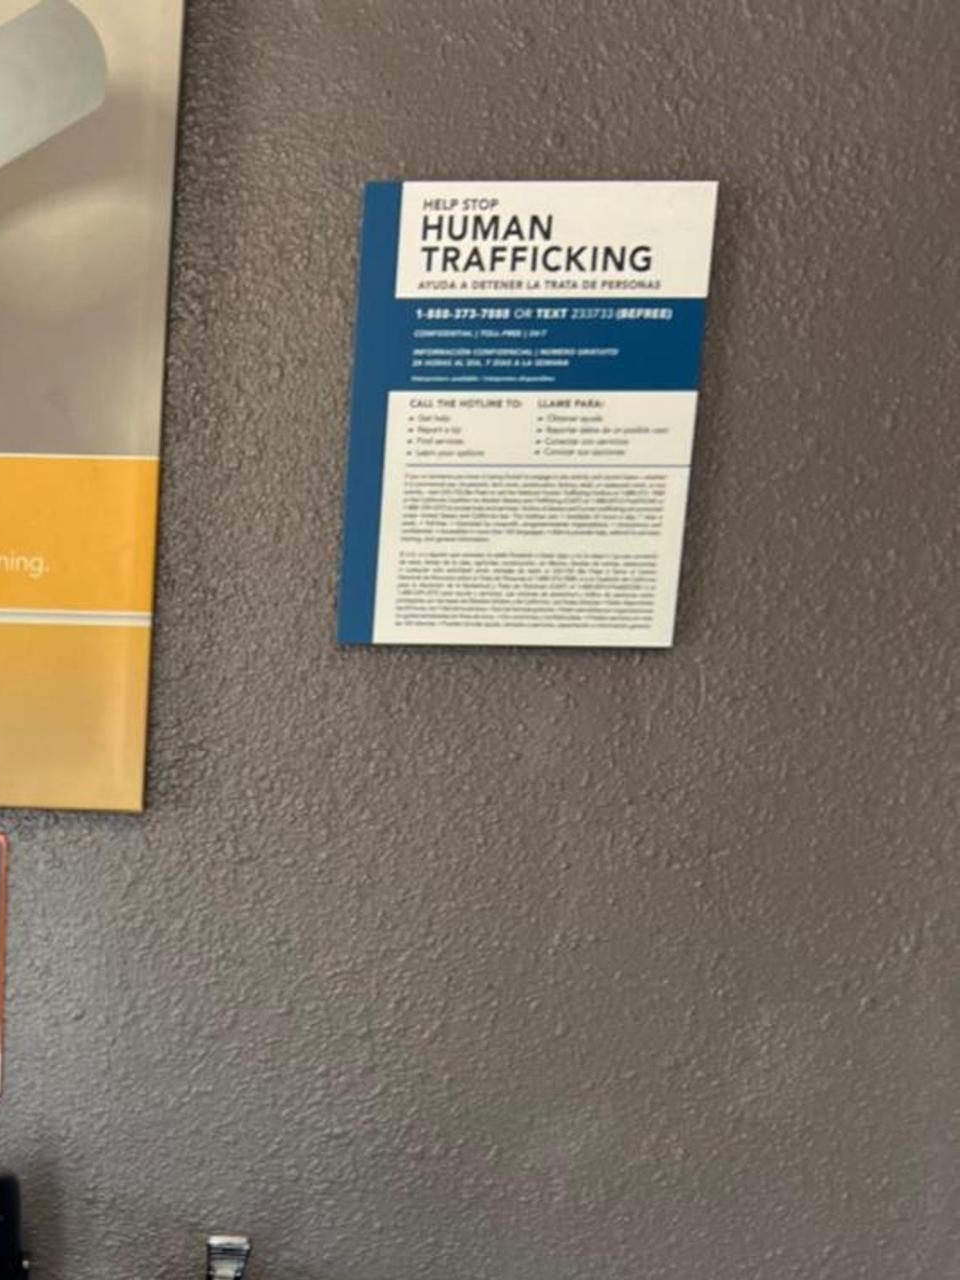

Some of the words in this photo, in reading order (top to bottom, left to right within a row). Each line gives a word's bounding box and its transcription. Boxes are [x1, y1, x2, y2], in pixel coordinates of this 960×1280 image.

[423, 198, 458, 211] HELP
[462, 198, 499, 211] STOP
[420, 214, 553, 241] HUMAN
[420, 245, 653, 272] TRAFFICKING
[418, 280, 456, 290] AYUDA
[459, 280, 468, 290] A
[471, 280, 524, 290] DETENER
[526, 280, 540, 290] LA
[544, 280, 578, 290] TRATA
[582, 280, 597, 290] DE
[600, 280, 662, 290] PERSONAS
[513, 308, 532, 319] OR
[536, 308, 568, 319] TEXT
